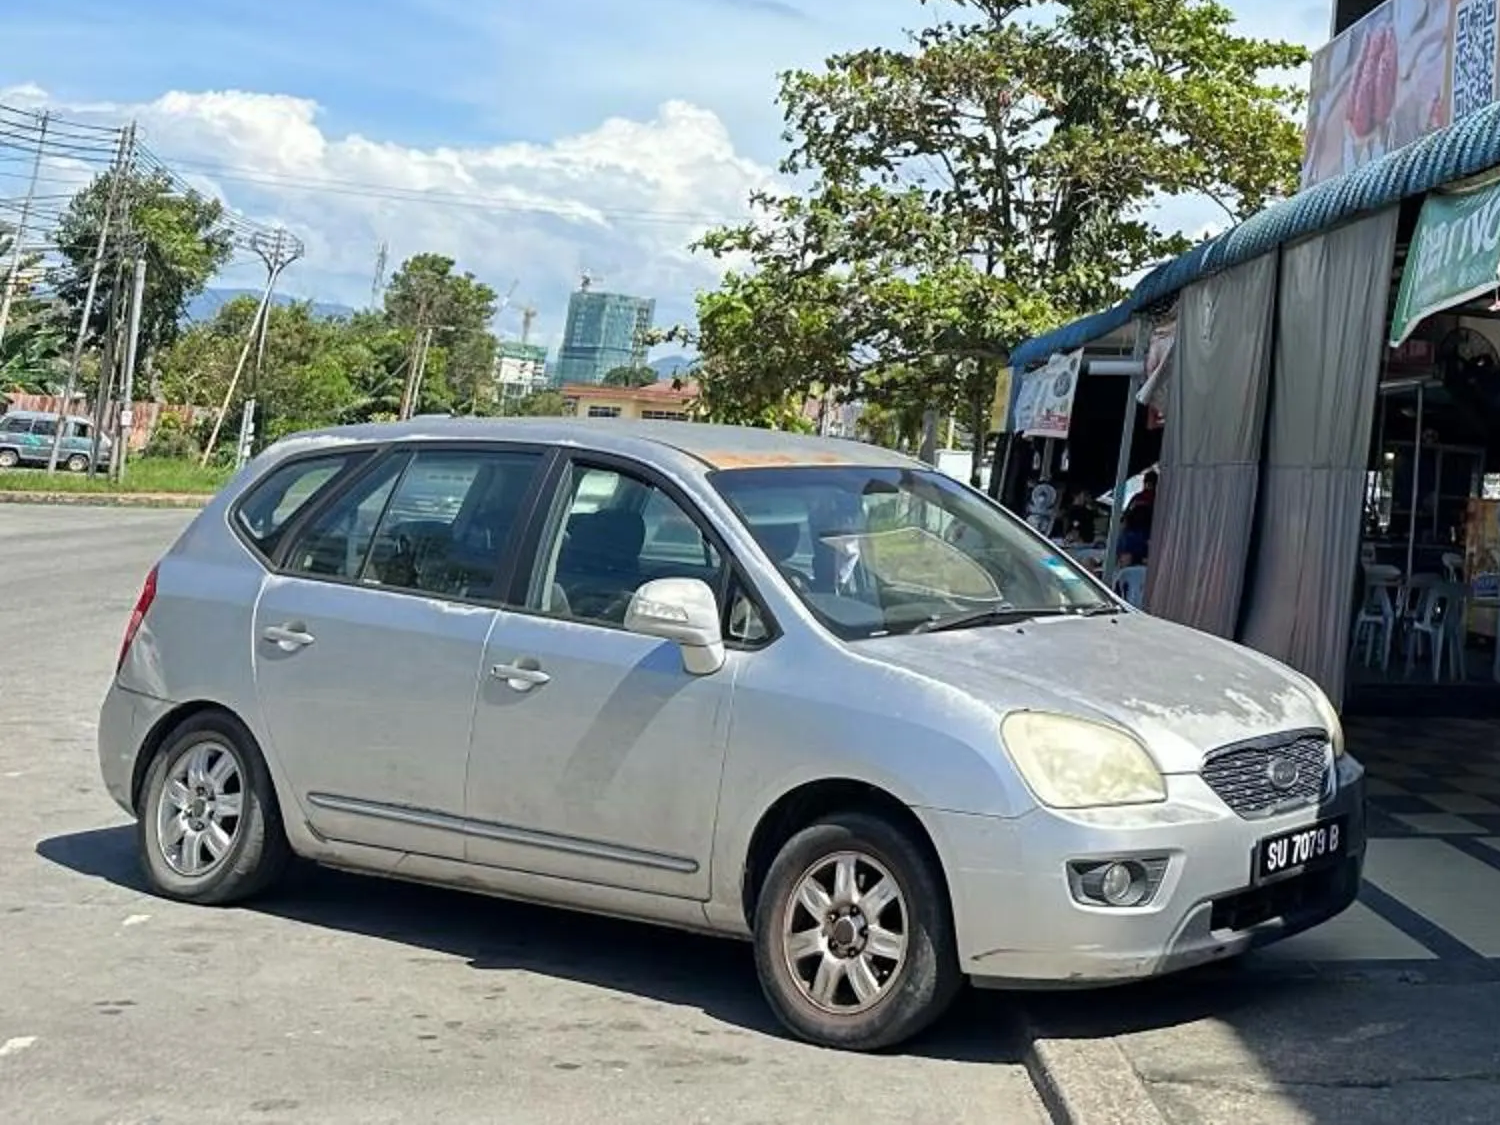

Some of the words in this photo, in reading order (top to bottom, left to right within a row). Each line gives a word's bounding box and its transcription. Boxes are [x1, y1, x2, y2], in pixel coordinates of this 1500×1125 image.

[1267, 838, 1289, 871] SU
[1291, 828, 1327, 864] 7079
[1329, 824, 1340, 852] B
